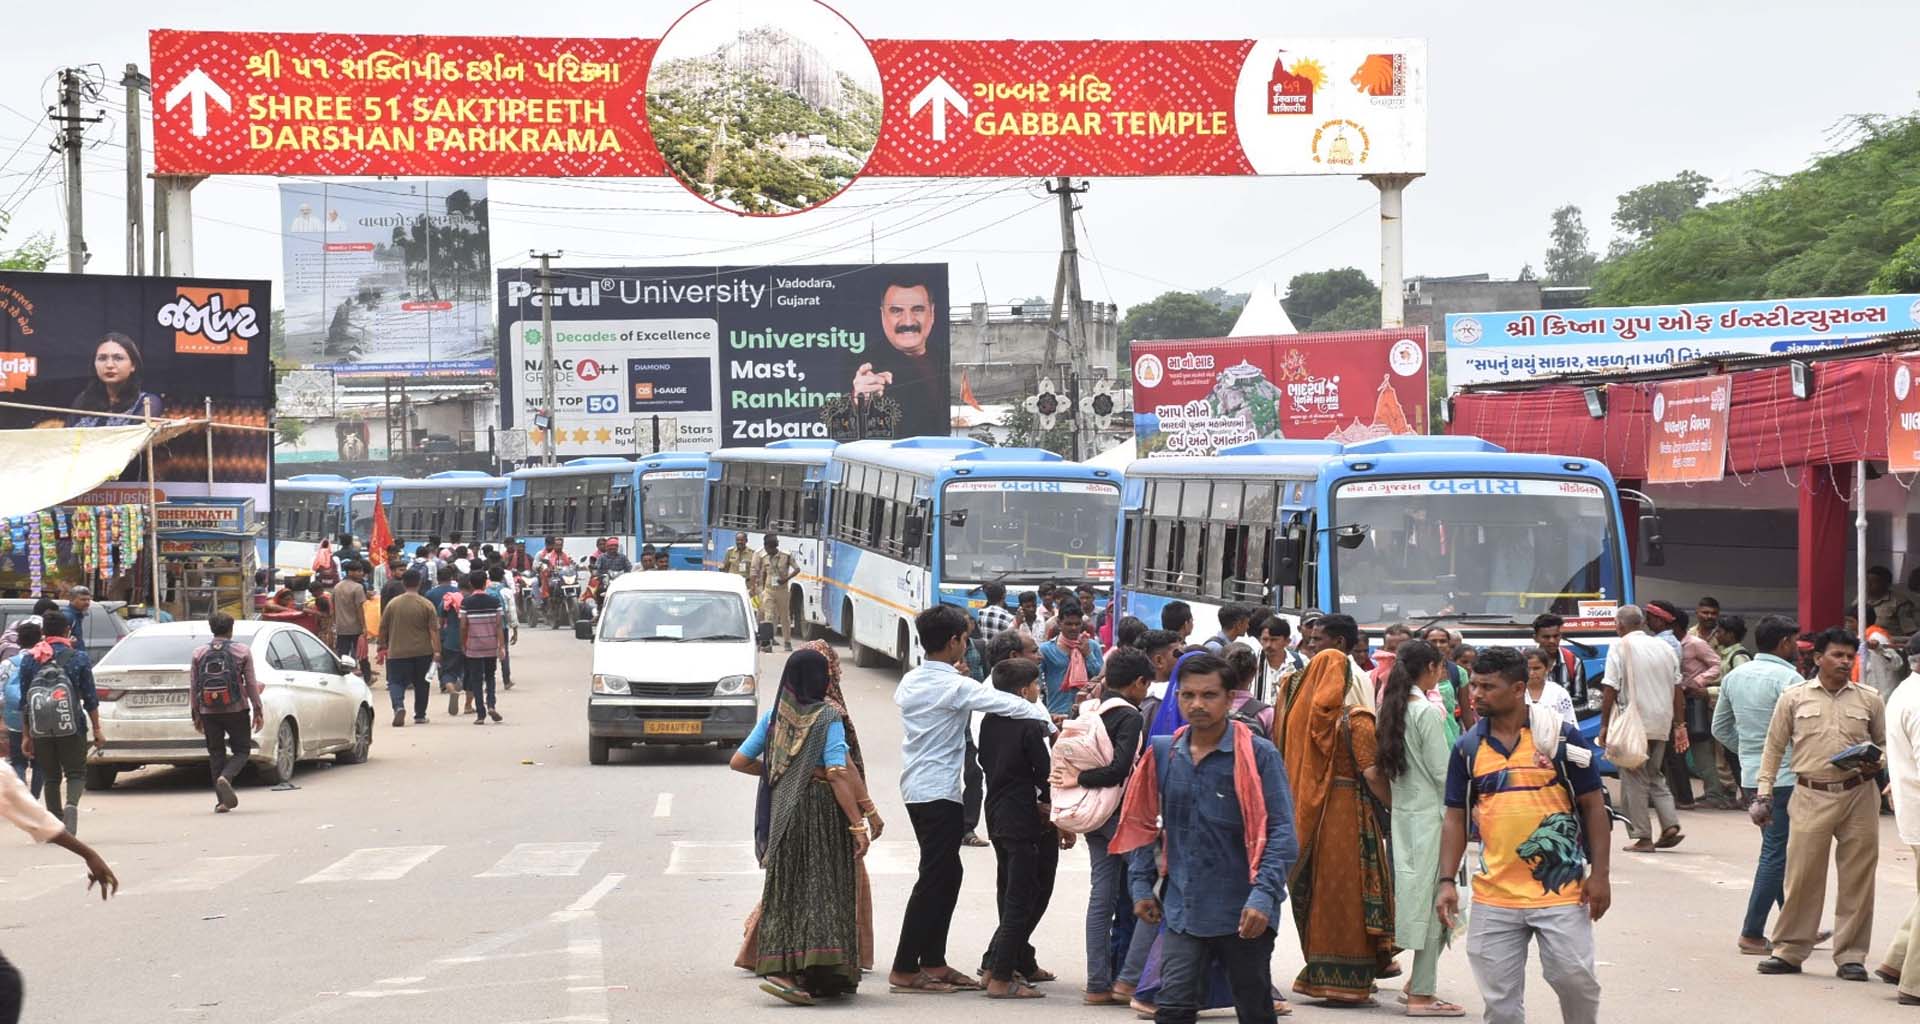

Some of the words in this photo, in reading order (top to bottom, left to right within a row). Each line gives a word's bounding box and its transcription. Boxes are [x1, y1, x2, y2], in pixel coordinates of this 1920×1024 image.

[246, 49, 281, 79] શ્રી
[466, 52, 524, 82] દર્શન
[973, 81, 1051, 103] ગબ્બર
[1060, 73, 1113, 104] મંદિર
[247, 95, 354, 121] SHREE
[364, 96, 401, 121] 51
[412, 97, 606, 123] SAKTIPEETH
[974, 112, 1102, 136] GABBAR
[1115, 110, 1228, 136] TEMPLE
[247, 125, 415, 151] DARSHAN
[426, 126, 622, 152] PARIKRAMA
[620, 278, 765, 308] University
[776, 277, 836, 290] Vadodara,
[776, 294, 821, 308] Gujarat
[556, 332, 617, 343] Decades
[620, 330, 634, 341] of
[636, 330, 711, 341] Excellence
[1506, 315, 1535, 337] શ્રી
[1542, 314, 1605, 337] ક્રિષ્ના
[1612, 316, 1651, 340] ગ્રુપ
[1657, 309, 1713, 333] ઓફ
[730, 327, 865, 353] University
[730, 359, 806, 381] Mast,
[1511, 354, 1537, 375] થયું
[1642, 346, 1674, 366] મળી
[558, 397, 583, 406] TOP
[589, 396, 616, 412] 50
[1158, 407, 1181, 418] આપ
[680, 425, 713, 434] Stars
[1189, 432, 1209, 446] અને
[1428, 479, 1522, 495] બનાસ
